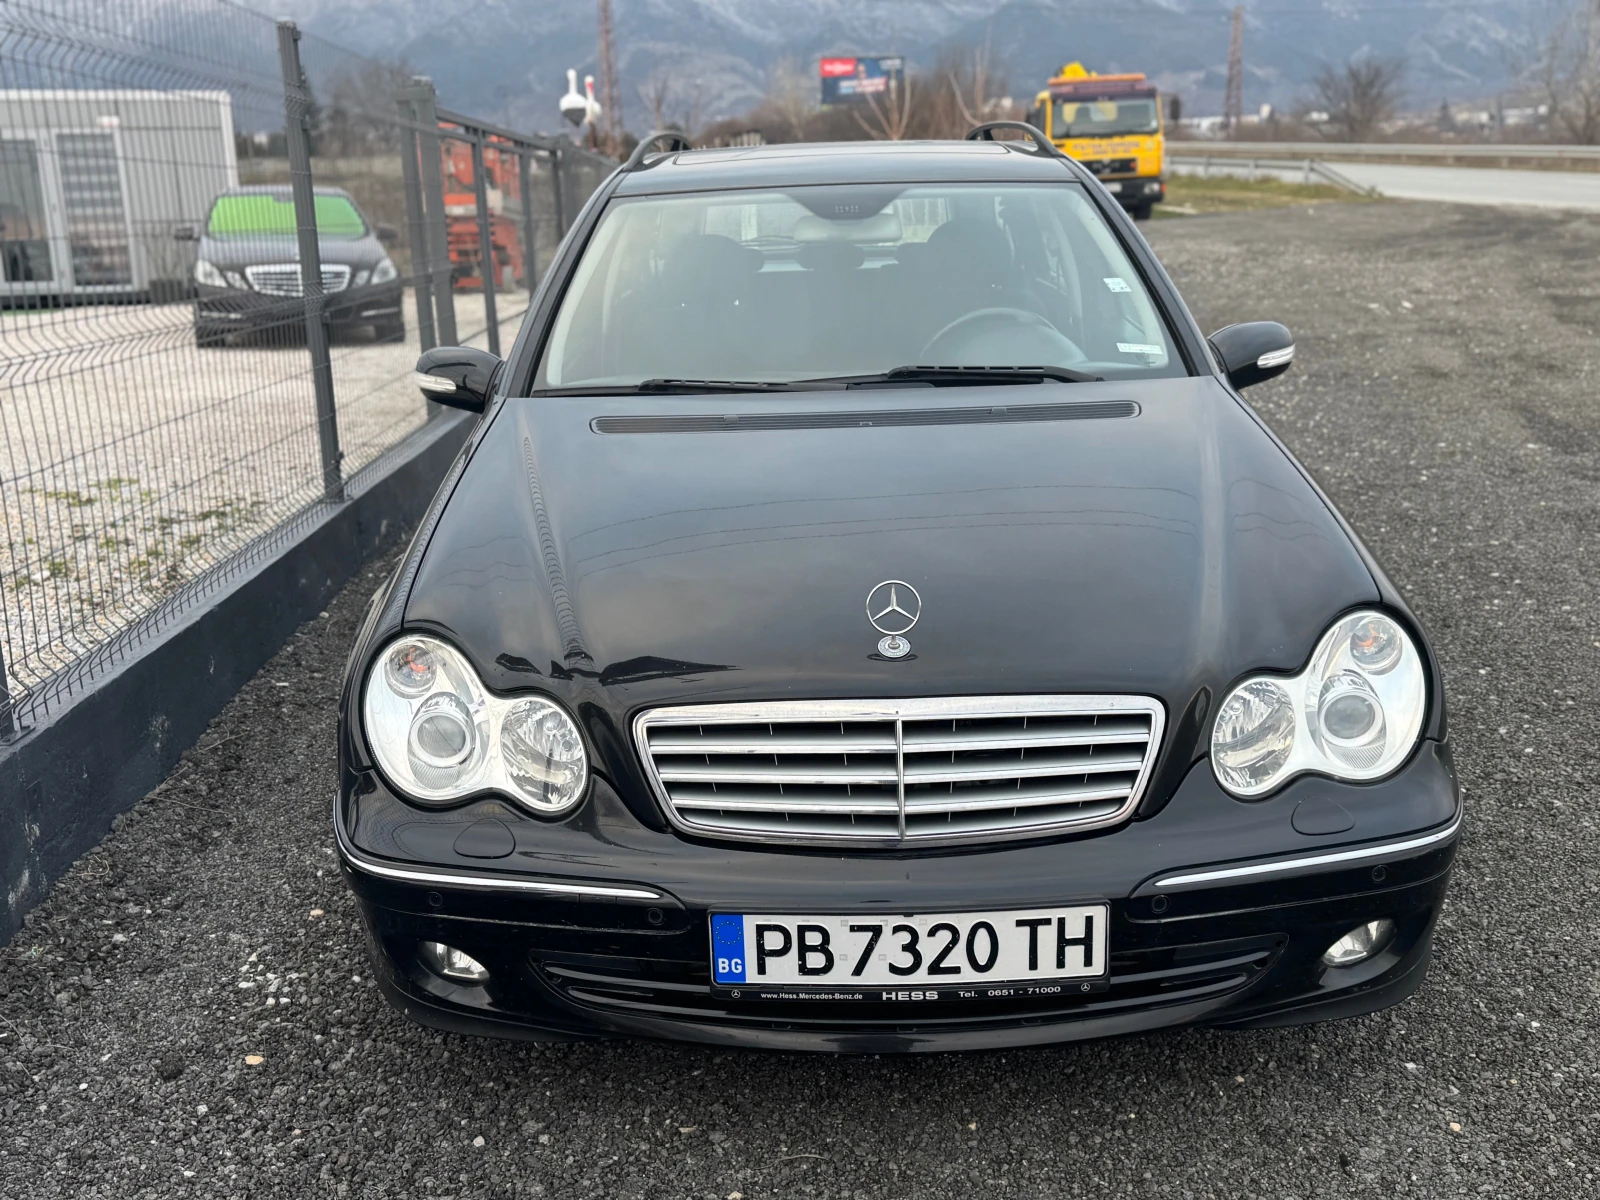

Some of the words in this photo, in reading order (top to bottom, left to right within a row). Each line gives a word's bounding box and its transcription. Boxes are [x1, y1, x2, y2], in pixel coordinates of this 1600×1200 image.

[755, 923, 835, 976] PB
[849, 920, 999, 977] 7320
[1015, 914, 1094, 971] TH
[718, 958, 743, 974] BG
[760, 992, 864, 1000] www.Hess.Mercedes-Benz.de
[881, 991, 940, 1001] HESS
[987, 988, 1015, 996] 0651
[1027, 986, 1061, 994] 71000
